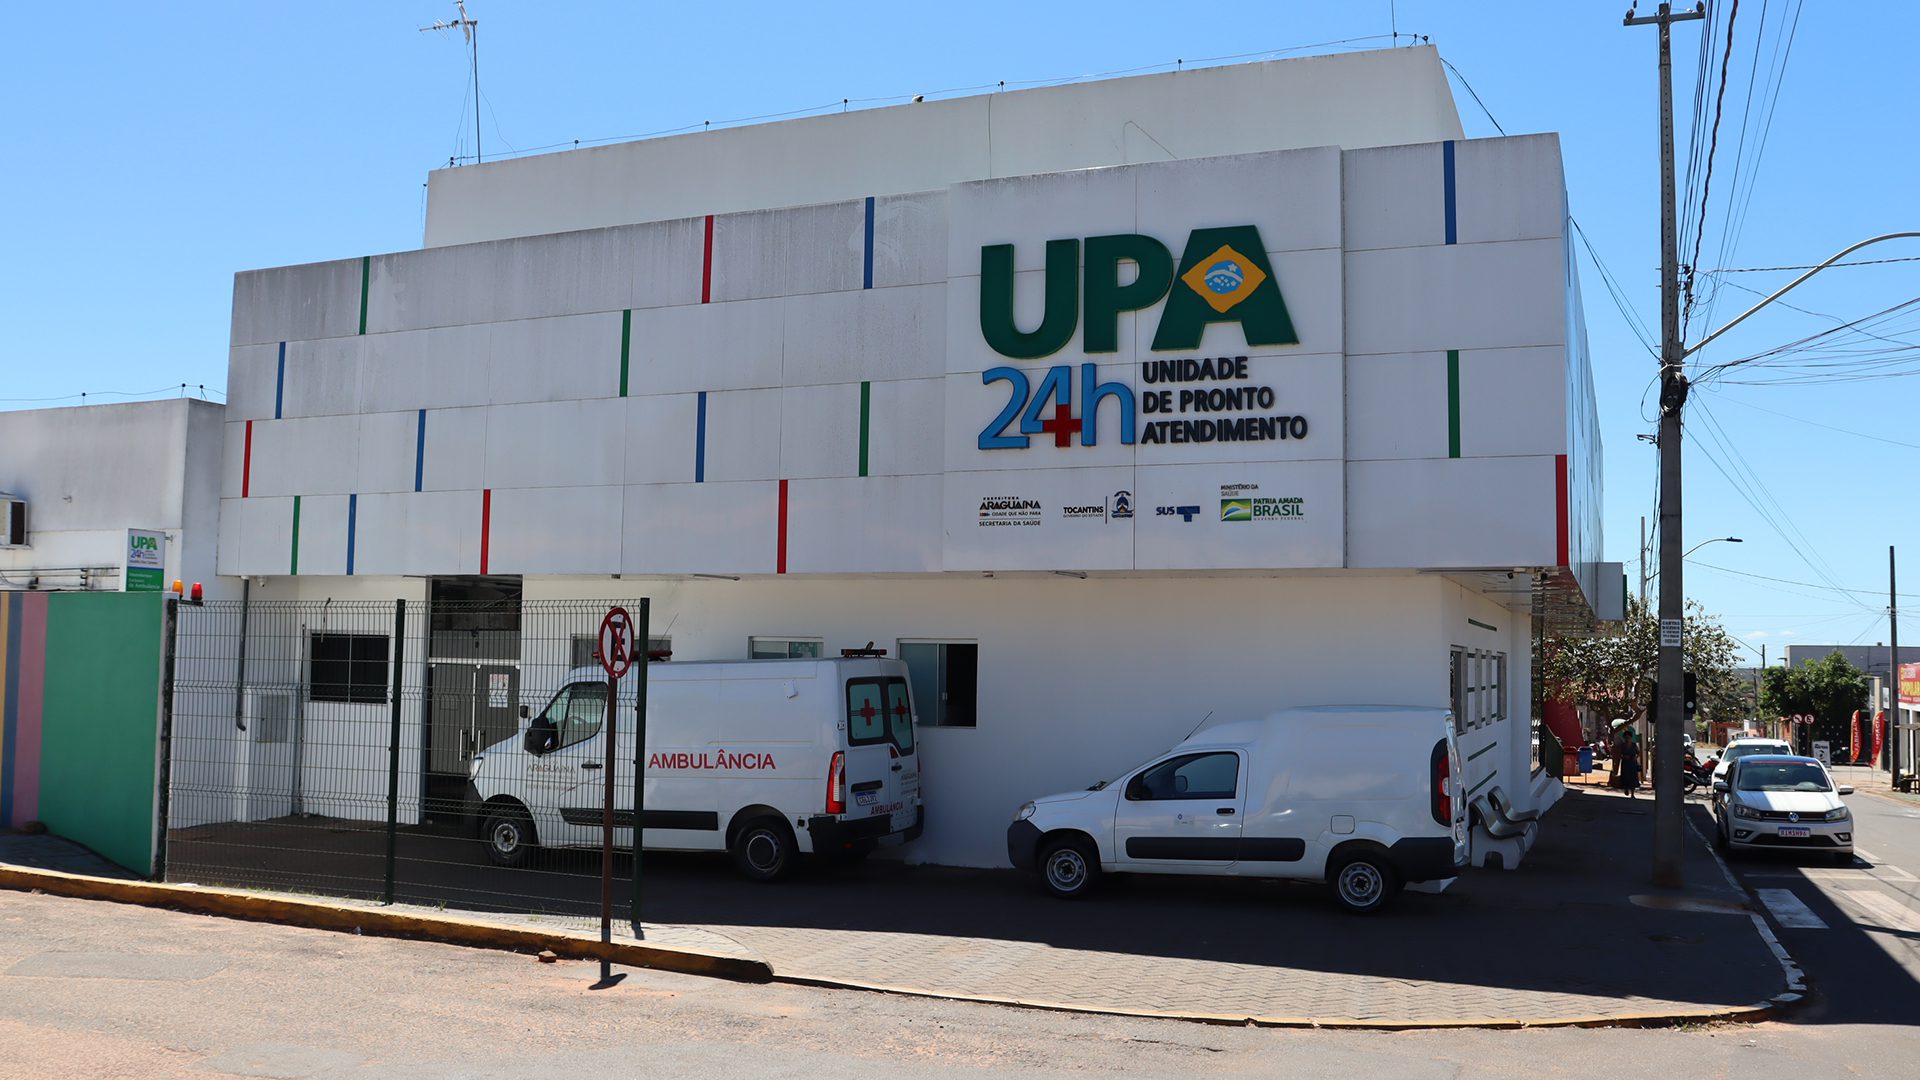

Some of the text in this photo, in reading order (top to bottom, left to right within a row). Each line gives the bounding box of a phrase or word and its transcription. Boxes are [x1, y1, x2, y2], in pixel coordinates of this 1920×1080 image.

[980, 224, 1300, 359] UPA
[1142, 356, 1249, 383] UNIDADE
[978, 363, 1136, 450] 24h
[1142, 386, 1275, 414] DE PRONTO
[1140, 415, 1308, 444] ATENDIMENTO
[1063, 506, 1104, 514] TOCANTINS
[1156, 506, 1175, 516] SUS
[1253, 504, 1304, 517] BRASIL
[131, 536, 158, 550] UPA
[648, 749, 776, 769] AMBULÂNCIA
